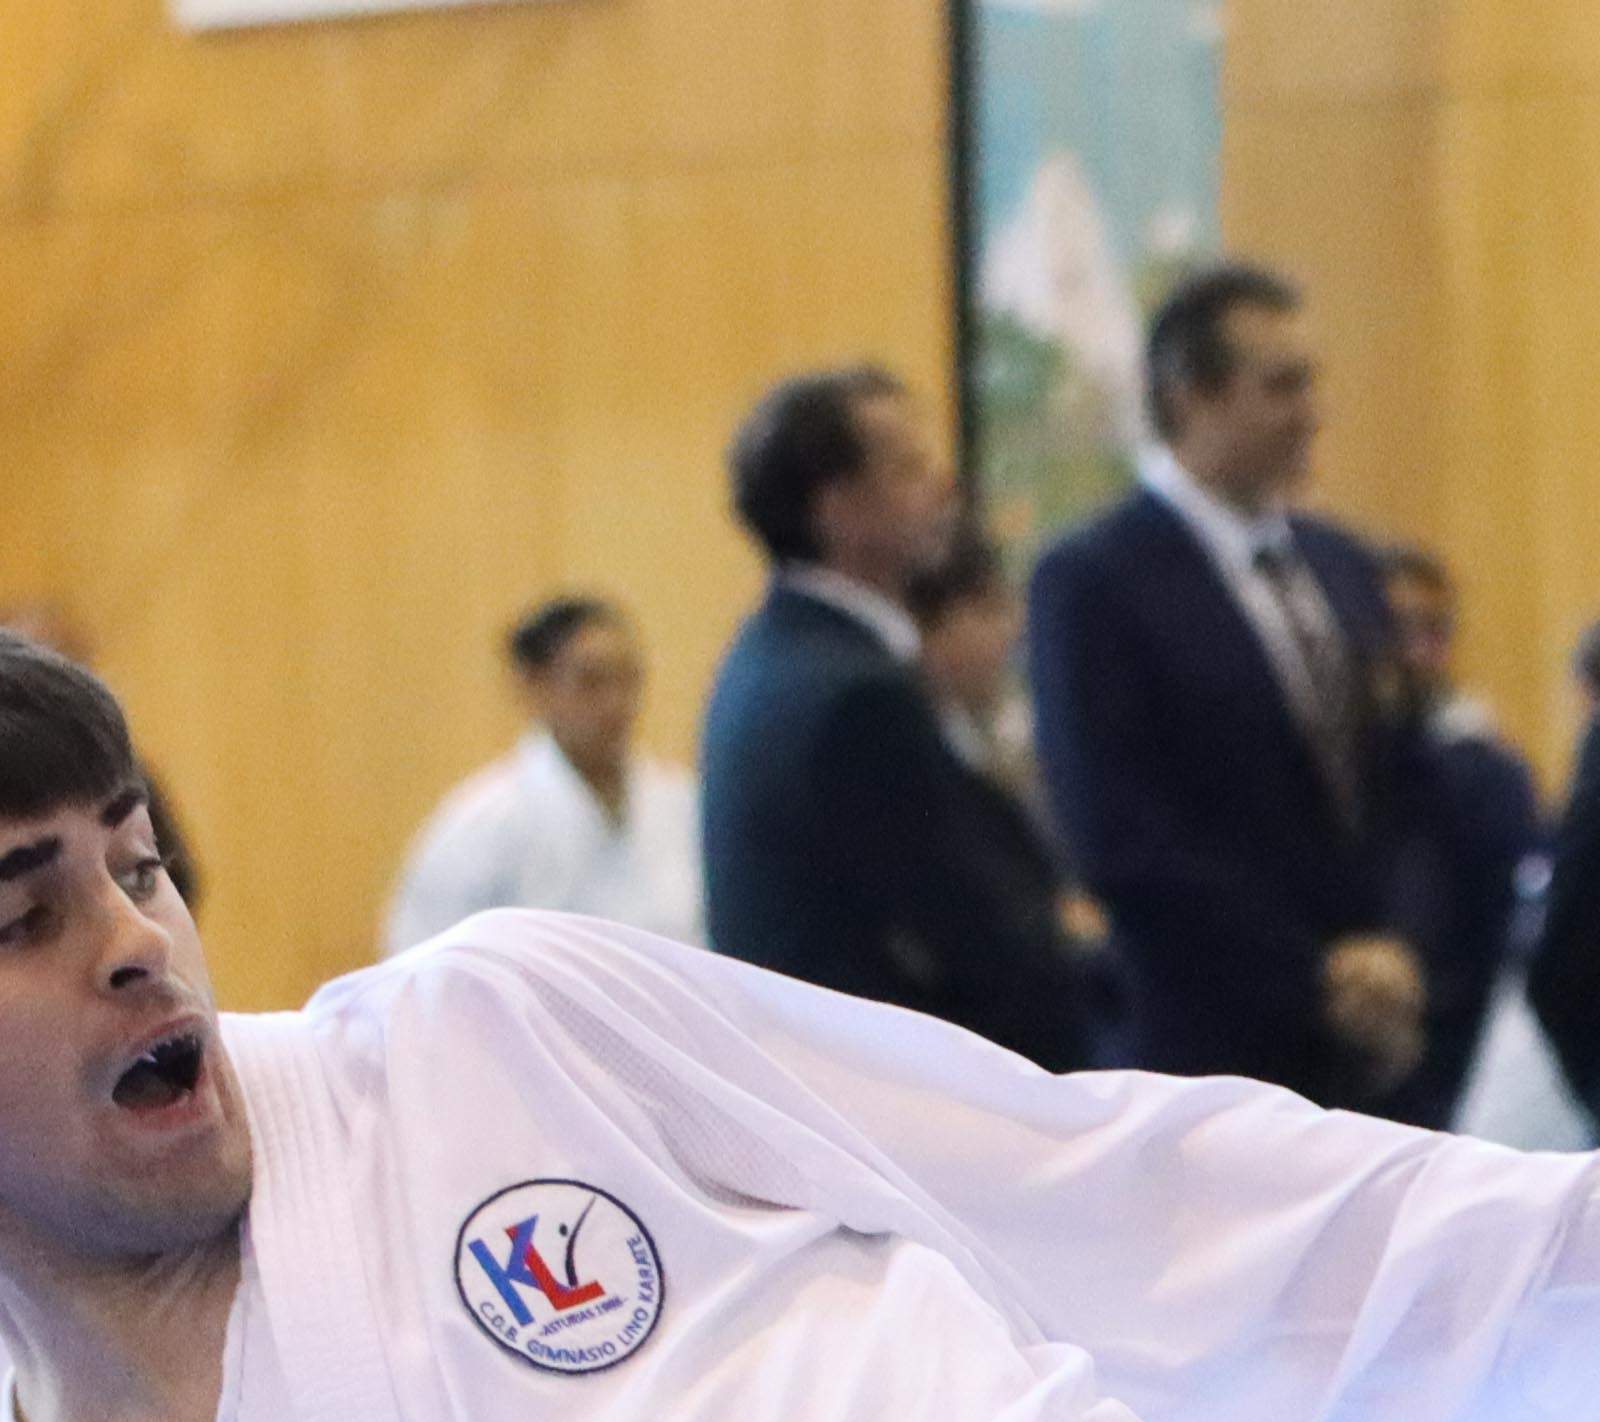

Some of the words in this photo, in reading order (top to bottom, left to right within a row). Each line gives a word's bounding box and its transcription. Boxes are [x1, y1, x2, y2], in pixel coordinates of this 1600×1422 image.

[626, 1233, 654, 1304] KARATE
[616, 1307, 649, 1347] LINO
[527, 1339, 616, 1364] GIMNASIO
